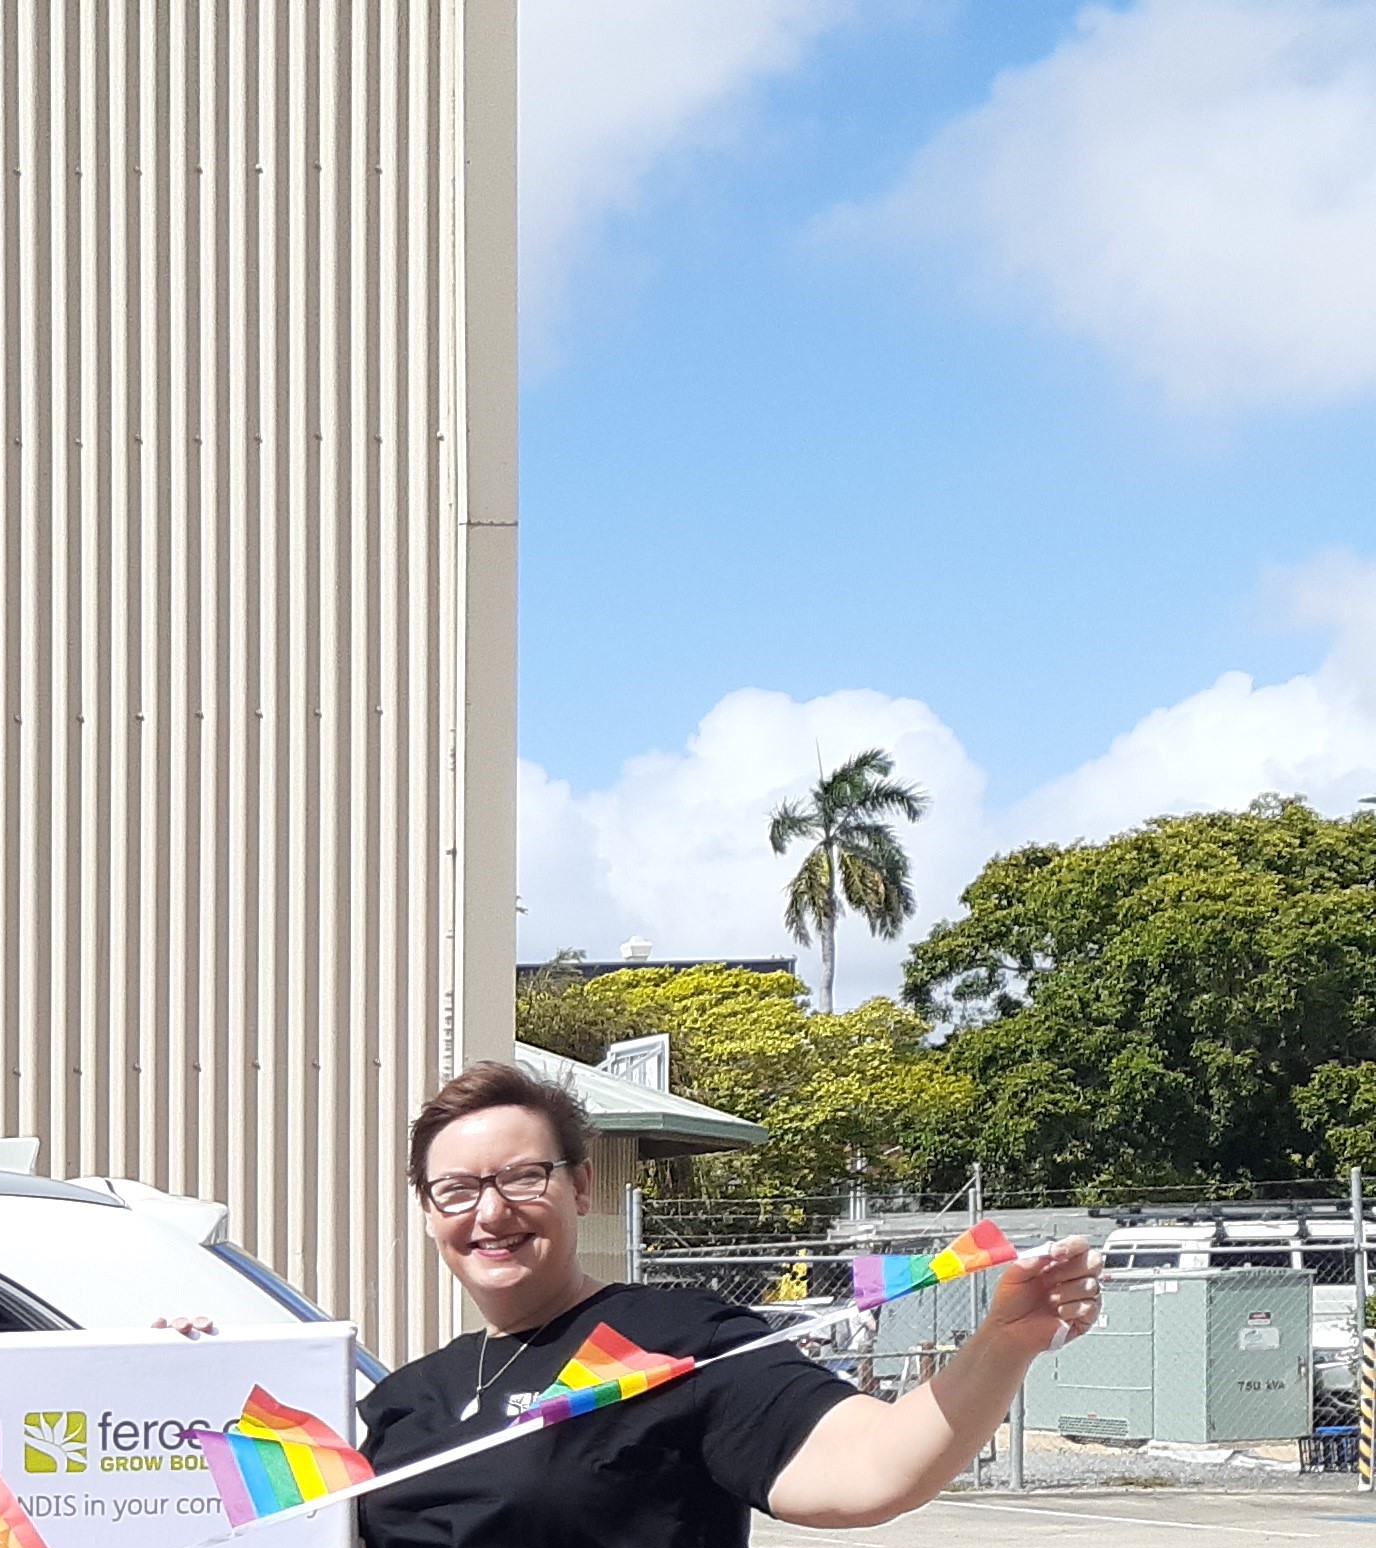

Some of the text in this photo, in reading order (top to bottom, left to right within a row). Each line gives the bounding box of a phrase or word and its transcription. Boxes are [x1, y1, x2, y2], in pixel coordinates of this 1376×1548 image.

[100, 1455, 209, 1472] GROW BOL
[84, 1493, 106, 1517] in
[112, 1496, 169, 1523] your
